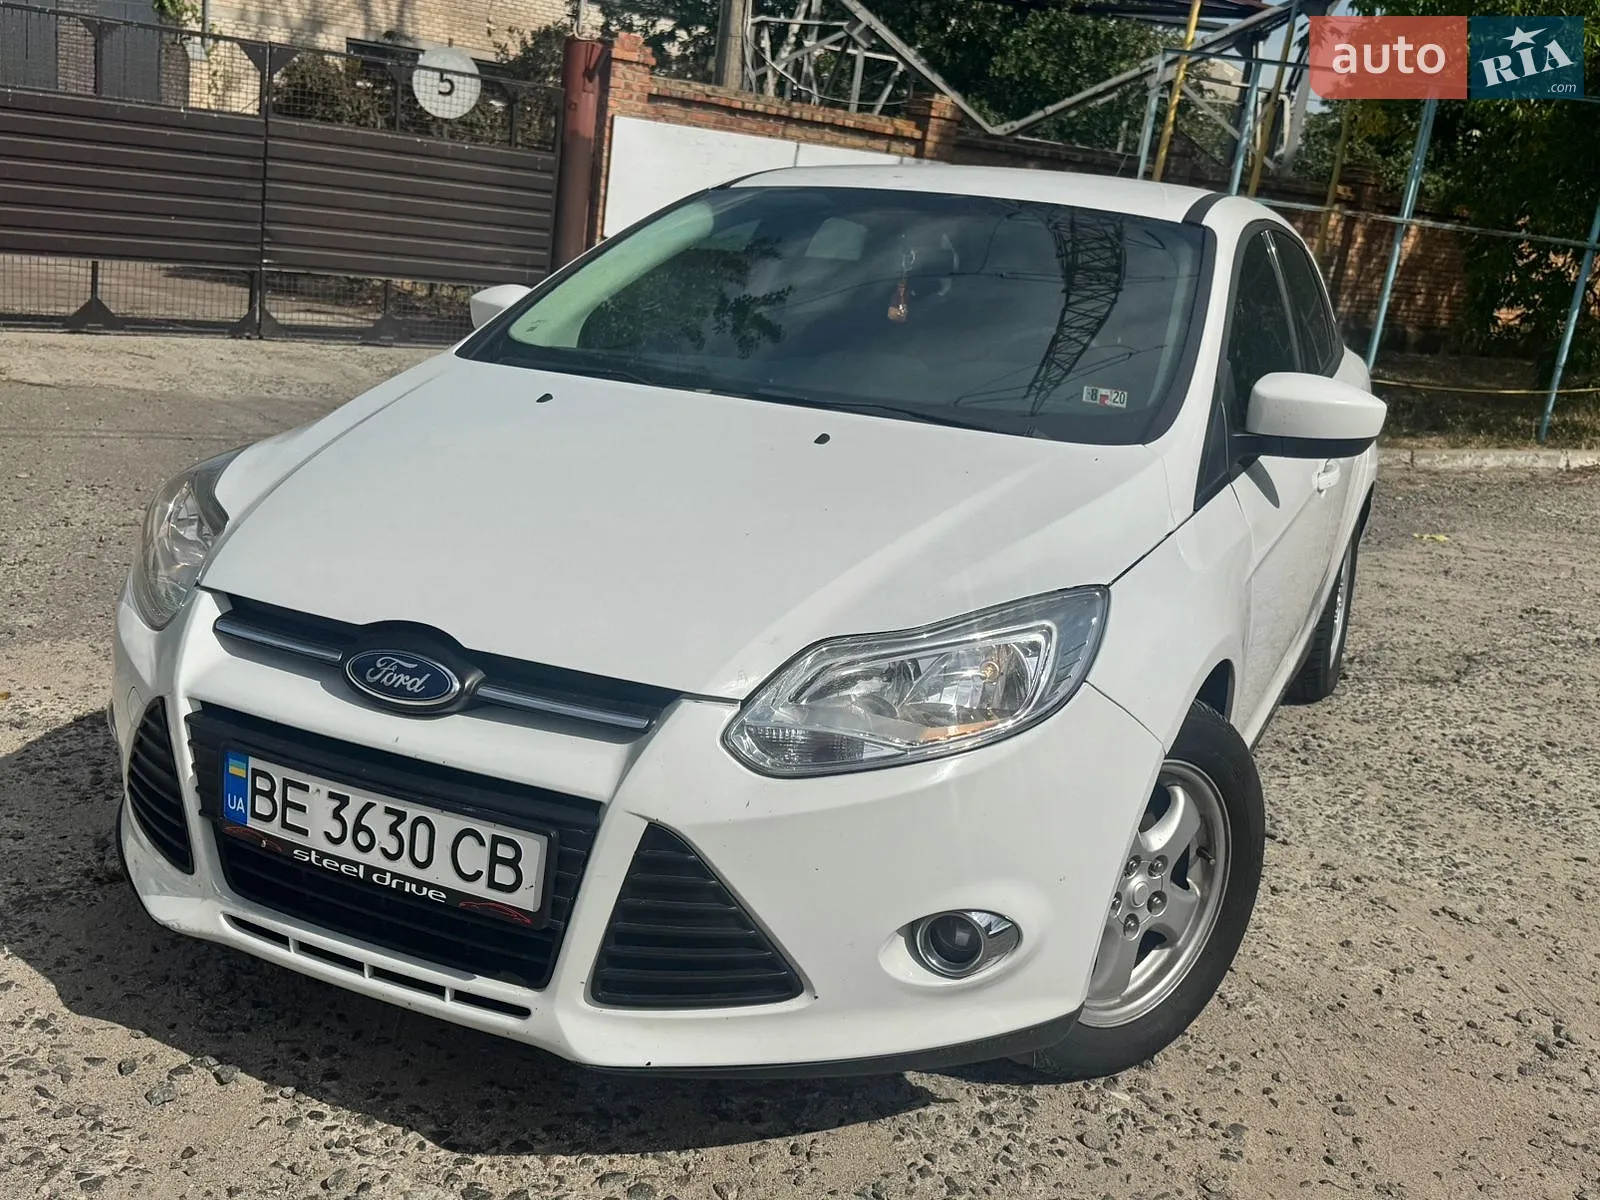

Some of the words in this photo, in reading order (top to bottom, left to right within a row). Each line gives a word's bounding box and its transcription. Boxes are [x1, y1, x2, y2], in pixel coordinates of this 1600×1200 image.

[438, 71, 455, 95] 5
[1112, 391, 1126, 404] 20
[366, 656, 431, 693] Ford
[228, 795, 246, 814] UA
[250, 767, 310, 837] BE
[323, 791, 436, 869] 3630
[451, 827, 523, 893] CB
[293, 848, 365, 880] steel
[372, 872, 447, 903] drive
